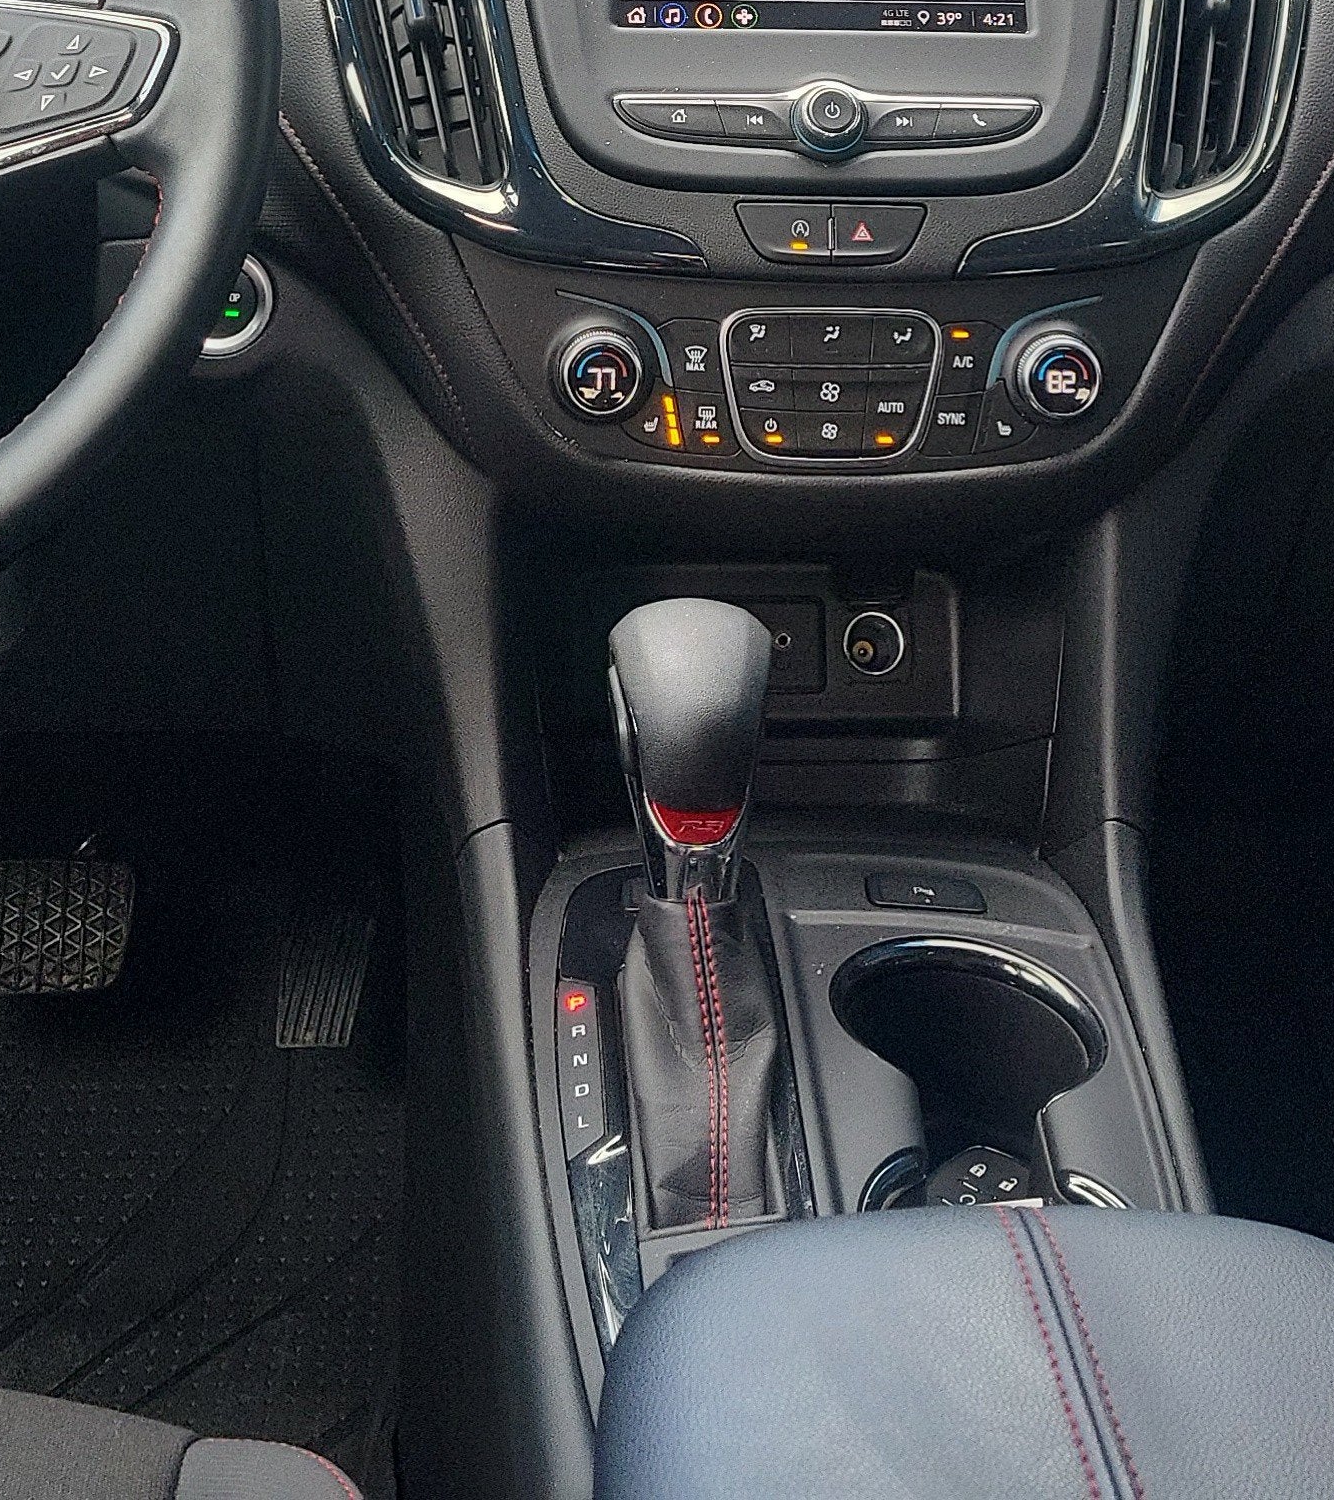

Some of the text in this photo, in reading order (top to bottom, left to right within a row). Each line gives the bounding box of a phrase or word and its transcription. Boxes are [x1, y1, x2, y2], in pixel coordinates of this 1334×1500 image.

[883, 9, 910, 17] 4G LTE
[936, 12, 962, 26] 39°
[983, 13, 1014, 26] 4:21
[686, 360, 706, 372] MAX
[953, 355, 974, 369] A/C
[1046, 370, 1076, 394] 82
[877, 402, 905, 414] AUTO
[695, 418, 718, 430] REAR
[937, 412, 966, 426] SYNC
[569, 995, 585, 1011] P
[571, 1024, 586, 1037] R
[573, 1053, 587, 1065] N
[574, 1082, 589, 1097] D
[578, 1116, 589, 1128] L
